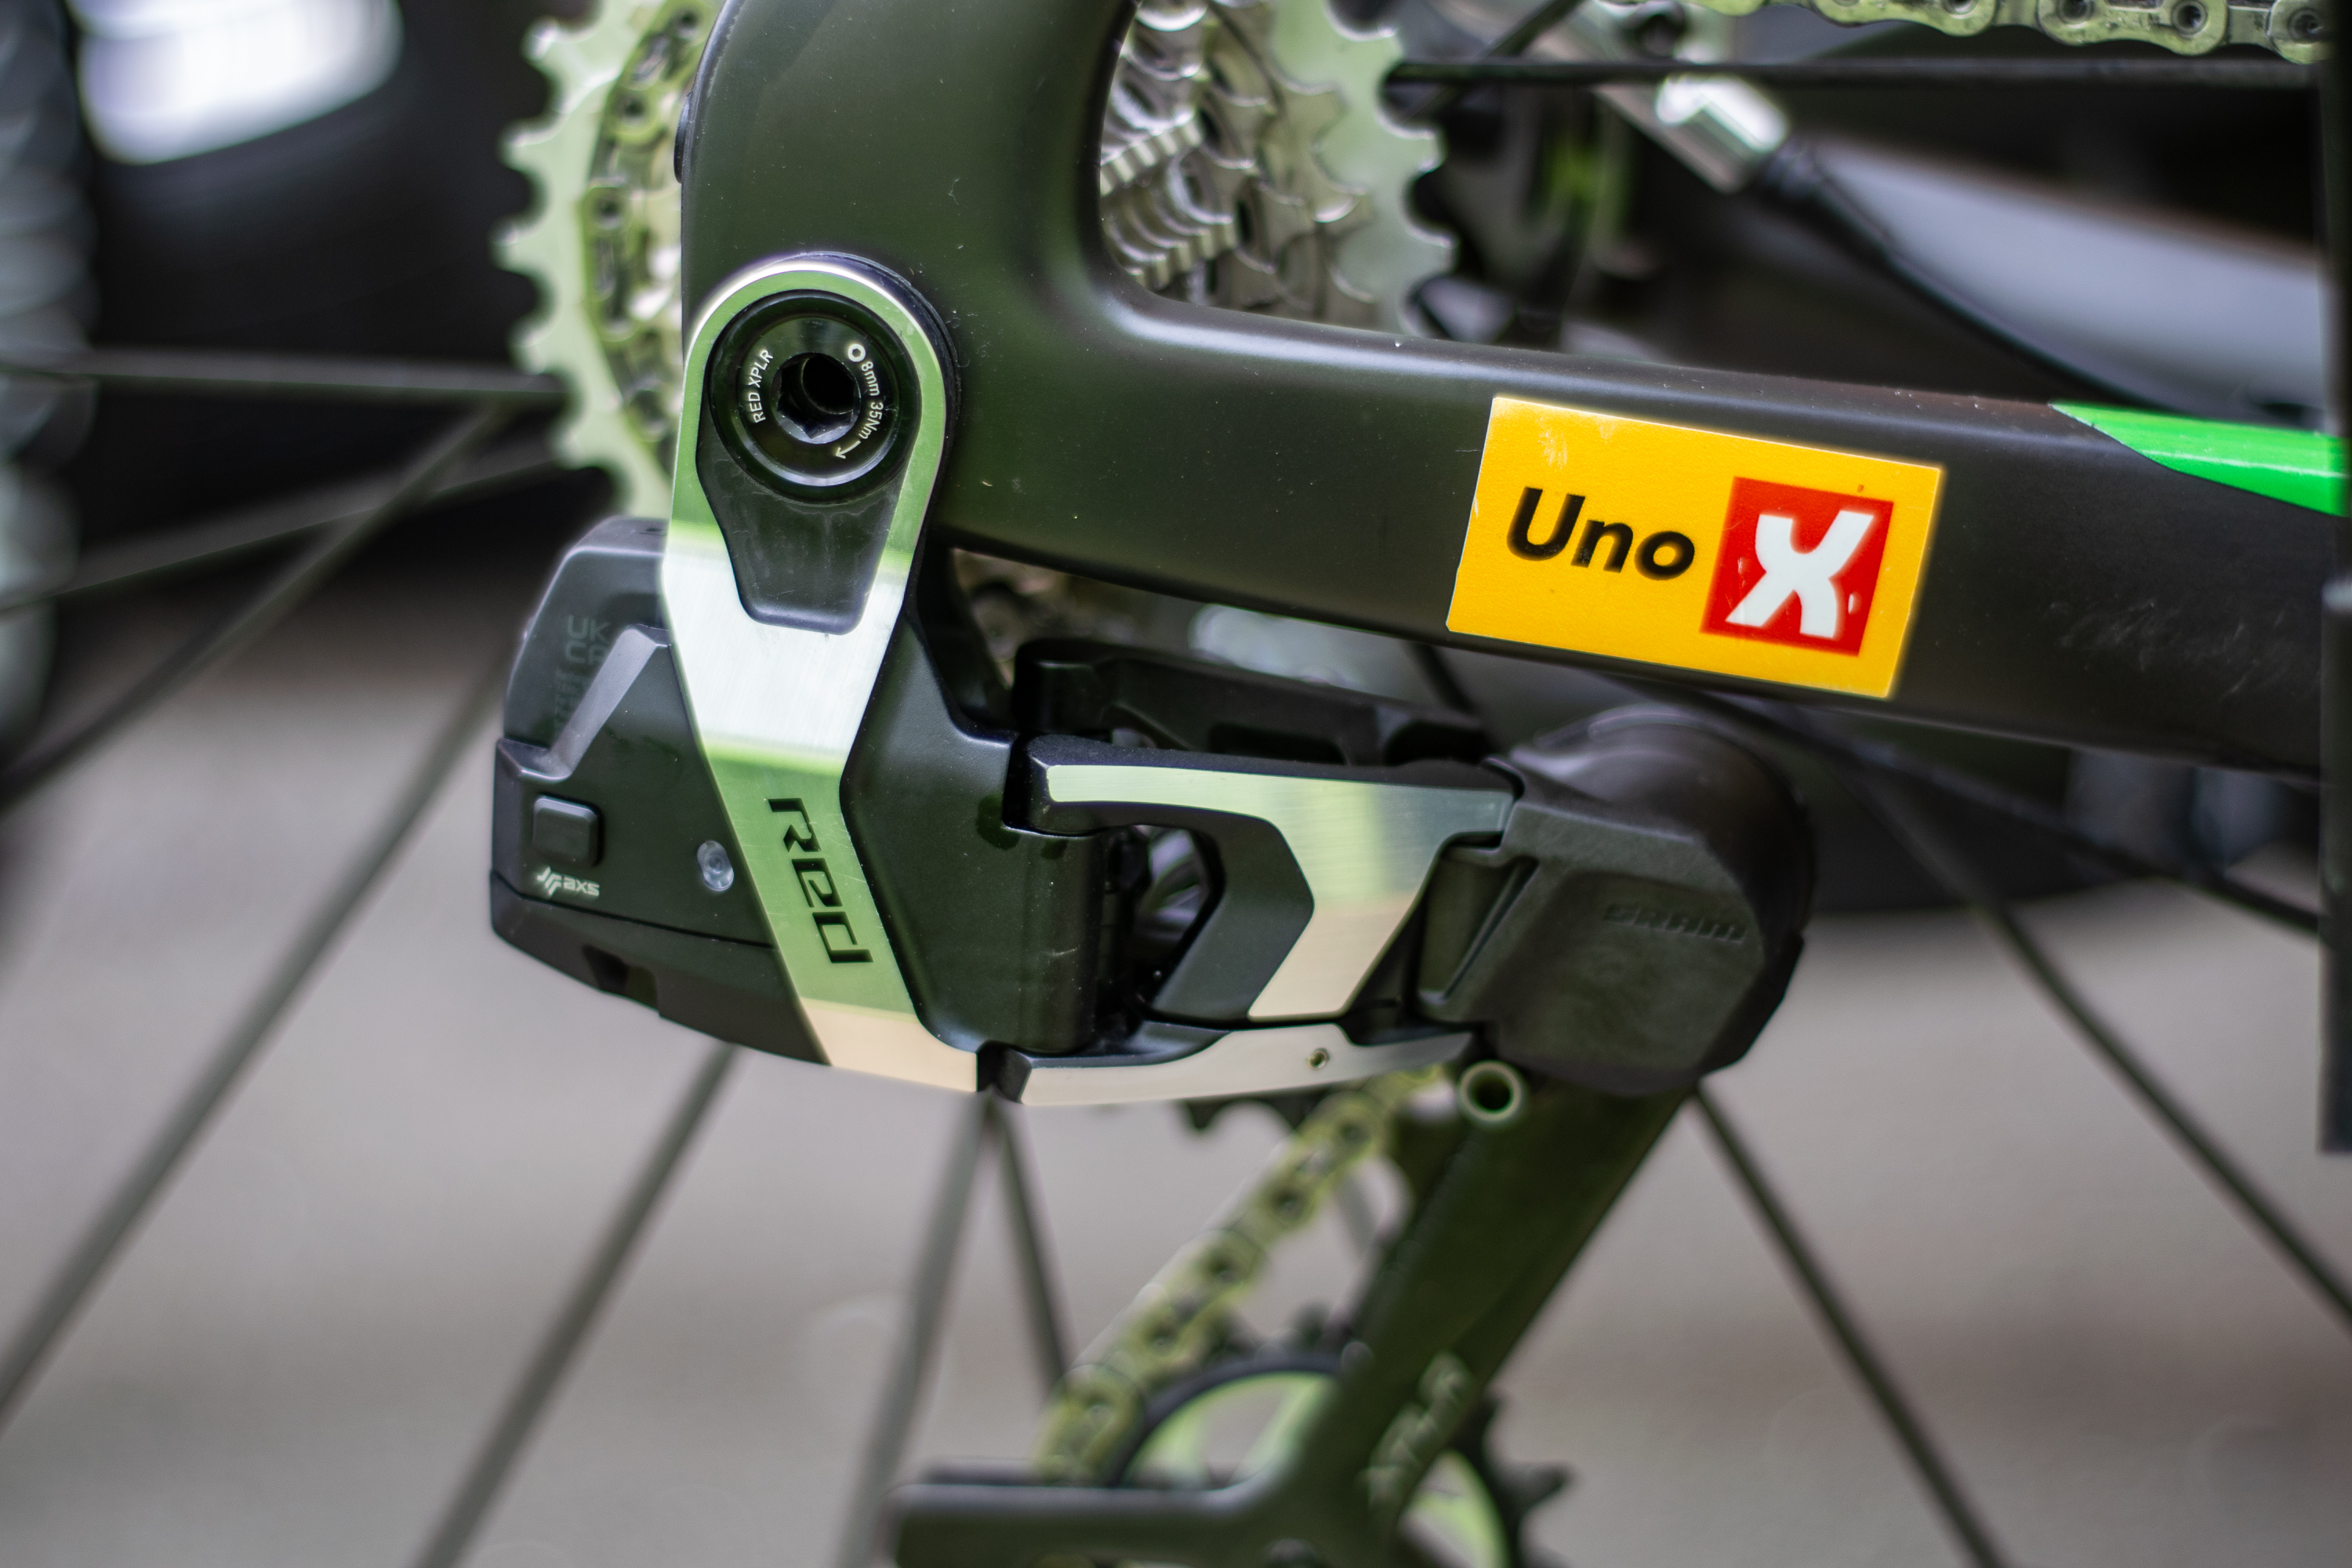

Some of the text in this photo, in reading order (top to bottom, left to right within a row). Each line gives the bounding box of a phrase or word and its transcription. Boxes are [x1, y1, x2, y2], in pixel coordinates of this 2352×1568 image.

[748, 349, 774, 423] RED XPLR
[858, 361, 884, 440] 8mm 35Nm
[1507, 486, 1875, 639] Uno X
[567, 615, 611, 644] UK
[1602, 902, 1747, 944] SRAM
